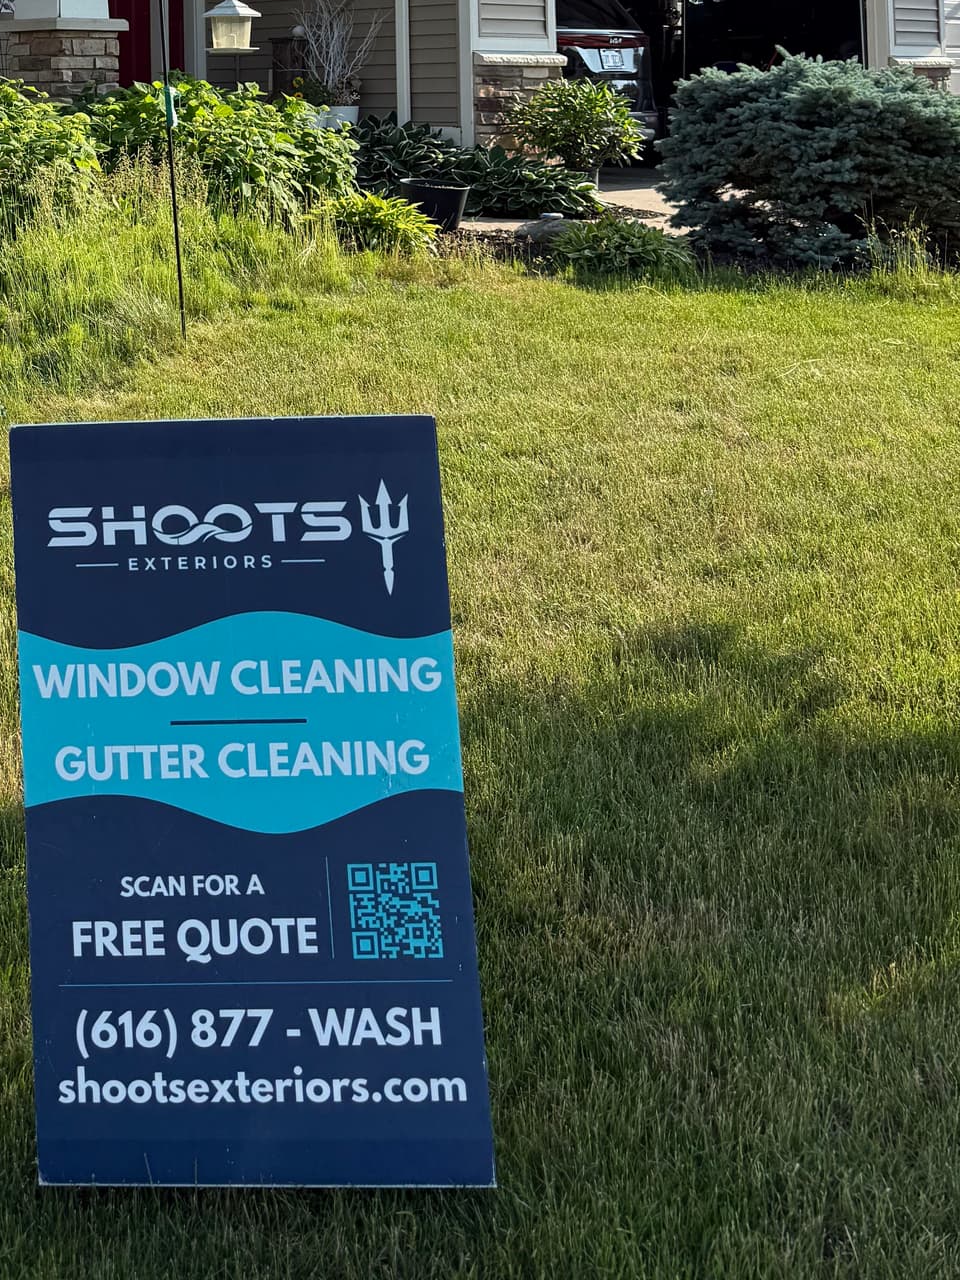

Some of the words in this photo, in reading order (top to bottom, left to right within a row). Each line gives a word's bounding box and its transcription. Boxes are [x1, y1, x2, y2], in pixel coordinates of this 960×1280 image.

[47, 501, 352, 547] SHOOTS
[128, 555, 273, 571] EXTERIORS
[32, 661, 221, 699] WINDOW
[230, 657, 442, 695] CLEANING
[55, 744, 209, 781] GUTTER
[217, 739, 430, 778] CLEANING
[120, 875, 186, 898] SCAN
[192, 874, 241, 896] FOR
[246, 874, 265, 895] A
[72, 920, 166, 957] FREE
[176, 917, 319, 964] QUOTE
[76, 1008, 178, 1059] (616)
[190, 1008, 274, 1048] 877
[308, 1006, 442, 1046] WASH
[58, 1065, 468, 1104] shootsexteriors.com
